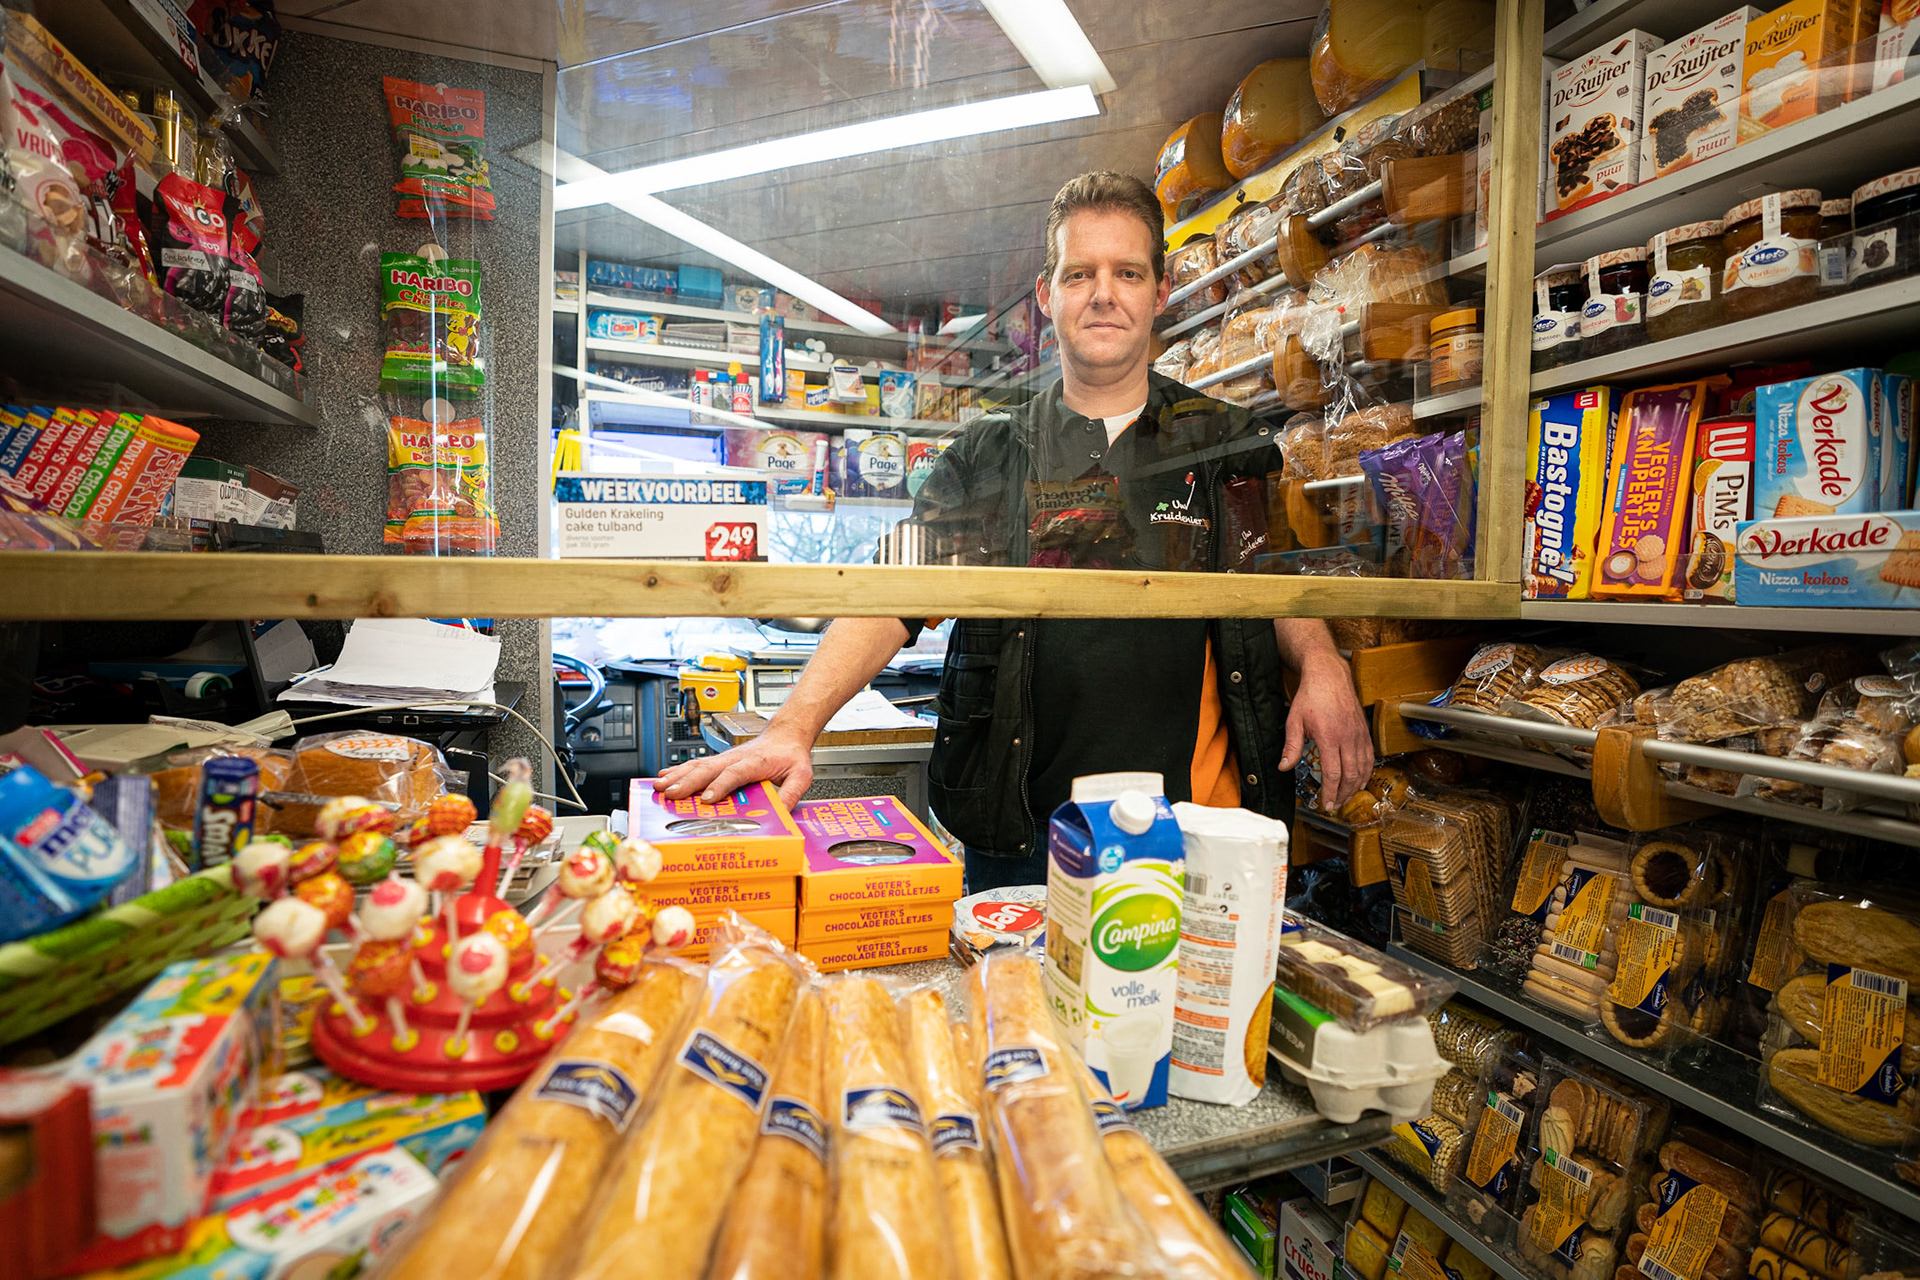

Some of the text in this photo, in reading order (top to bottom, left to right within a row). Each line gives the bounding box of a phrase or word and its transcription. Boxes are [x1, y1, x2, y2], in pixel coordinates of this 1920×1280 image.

[1747, 13, 1821, 57] De Ruijter
[1647, 38, 1741, 92] De Ruijter
[1554, 60, 1631, 107] De Ruijter
[51, 45, 146, 147] TOBLERONE
[394, 95, 478, 121] HARIBO
[1695, 135, 1730, 157] puur
[1595, 163, 1624, 182] puur
[1754, 249, 1787, 262] Hero
[391, 269, 473, 296] HARIBO
[1652, 283, 1672, 294] Hero
[398, 289, 467, 310] Cherries
[1585, 305, 1605, 316] Hero
[613, 323, 635, 333] Clean
[1535, 319, 1556, 331] Hero
[1580, 394, 1594, 407] LU
[1873, 381, 1882, 433] Verkade
[1901, 383, 1909, 439] Verkade
[28, 419, 67, 464] TONY'S
[51, 423, 88, 466] TONY'S
[77, 424, 112, 465] TONY'S
[94, 428, 130, 470] TONY'S
[1709, 426, 1748, 457] LU
[1776, 402, 1794, 475] Nizza kokos
[1809, 384, 1851, 497] Verkade
[113, 438, 148, 479] TONY'S
[767, 456, 796, 470] Page
[869, 457, 898, 471] Page
[581, 479, 746, 503] WEEKVOORDEEL
[1378, 472, 1420, 521] Milka
[1619, 427, 1657, 549] KNIJPERTJES
[1640, 440, 1671, 531] VEGTER'S
[1535, 421, 1578, 583] Bastogne!
[1713, 474, 1745, 531] PiM's
[565, 508, 664, 521] Gulden Krakeling
[565, 521, 643, 532] cake tulband
[1150, 513, 1204, 526] Kruidenier
[710, 525, 754, 557] 2.49
[1749, 520, 1889, 560] Verkade
[1759, 571, 1849, 586] Nizza kokos
[828, 802, 867, 839] CHOCOLADE
[847, 802, 886, 838] ROLLETJES
[662, 859, 779, 873] HOCOLADE ROLLETJES
[695, 852, 746, 863] VEGTER'S
[689, 885, 739, 896] VEGTER'S
[715, 891, 771, 903] ROLLETJES
[829, 886, 940, 901] CHOCOLADE ROLLETJES
[865, 880, 912, 891] VEGTER'S
[825, 914, 933, 932] CHOCOLADE ROLLETJES
[860, 909, 905, 921] VEGTER'S
[975, 904, 1031, 930] Jan
[856, 941, 901, 953] VEGTER'S
[1098, 915, 1177, 955] Campina
[822, 945, 928, 964] CHOCOLADE ROLLETJES
[1111, 980, 1144, 998] volle
[1127, 991, 1162, 1008] melk
